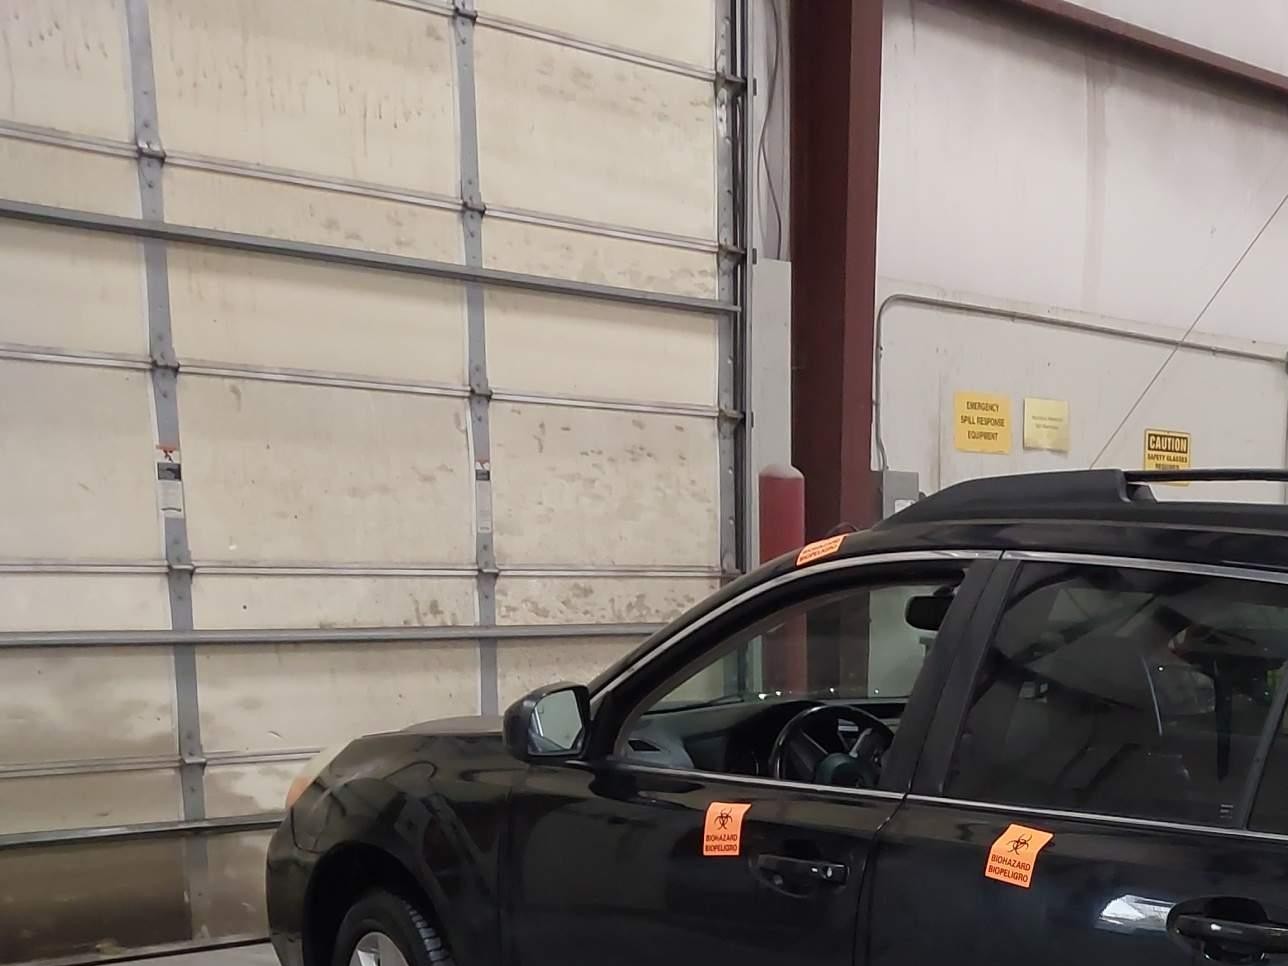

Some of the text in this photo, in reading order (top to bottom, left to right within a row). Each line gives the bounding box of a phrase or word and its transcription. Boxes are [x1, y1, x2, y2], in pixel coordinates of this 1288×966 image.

[966, 401, 999, 412] EMERGENCY
[960, 415, 1005, 427] SPILL RESPONSE
[968, 430, 998, 440] EQUIPMENT
[1149, 435, 1187, 452] CAUTION
[706, 834, 738, 842] BIOHAZARD
[704, 844, 738, 852] BIOPELIGRO
[990, 854, 1031, 871] BIOHAZARD
[988, 864, 1028, 882] BIOPELIGRO
